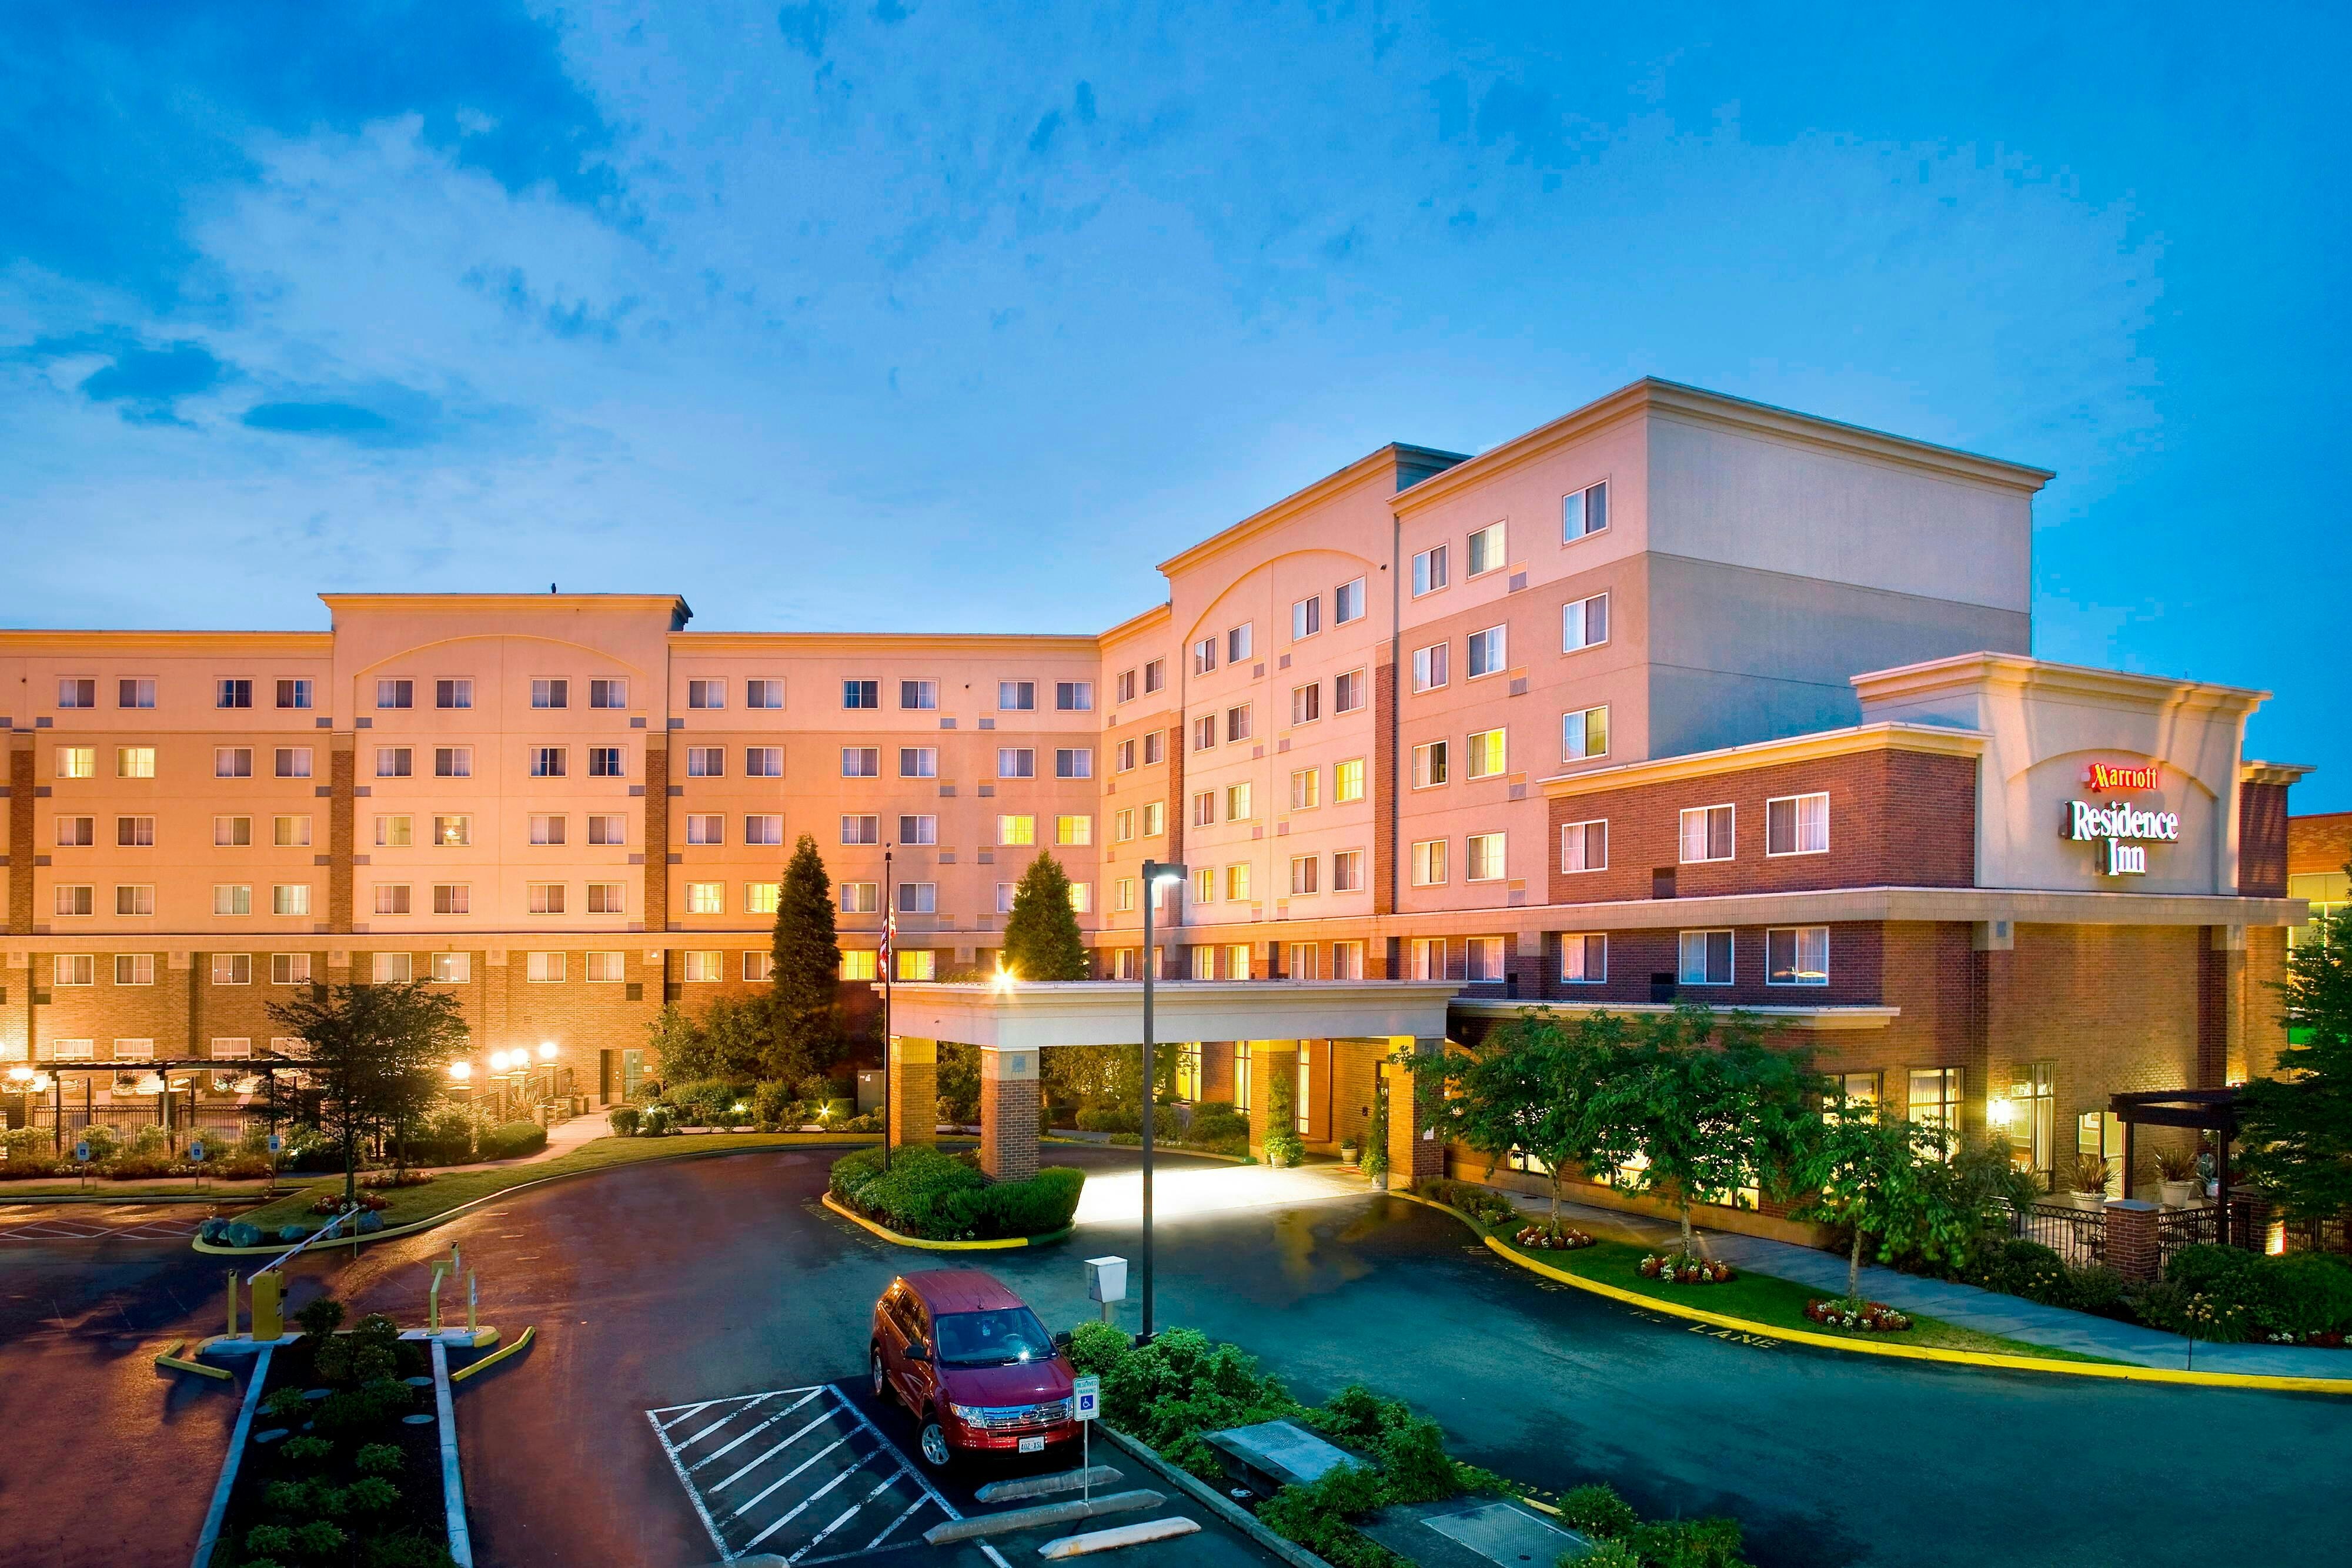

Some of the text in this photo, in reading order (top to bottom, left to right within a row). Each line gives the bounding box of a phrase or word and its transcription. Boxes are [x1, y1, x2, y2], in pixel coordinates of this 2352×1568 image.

[2090, 763, 2158, 790] Marriott
[2071, 800, 2179, 841] Residence
[2108, 837, 2146, 876] Inn
[1688, 1323, 1781, 1349] LANE
